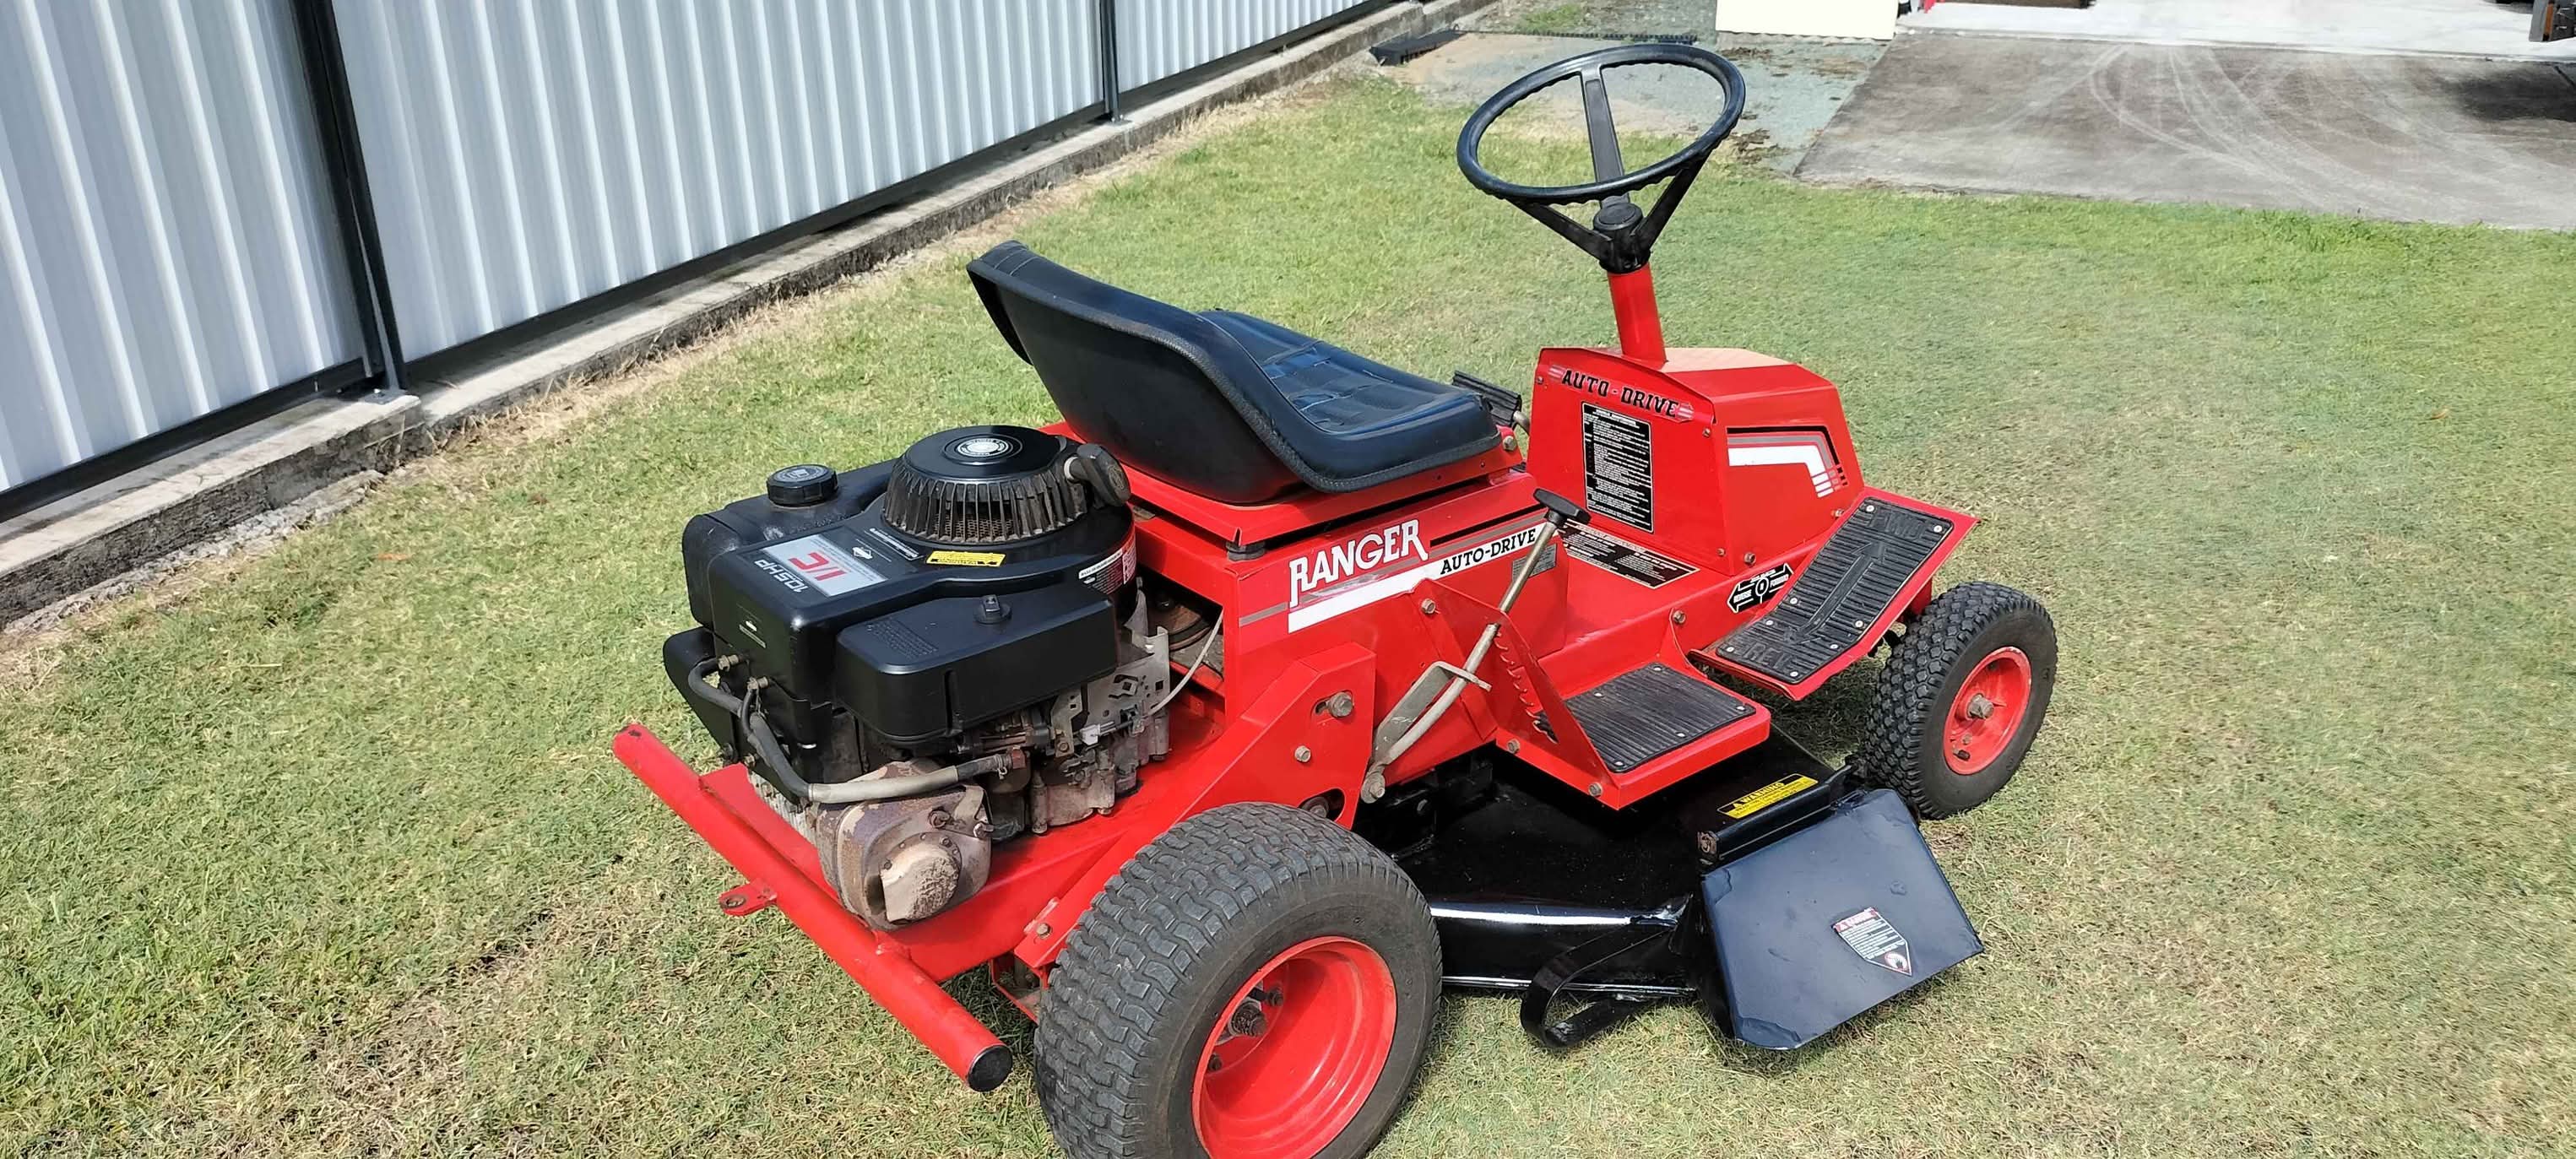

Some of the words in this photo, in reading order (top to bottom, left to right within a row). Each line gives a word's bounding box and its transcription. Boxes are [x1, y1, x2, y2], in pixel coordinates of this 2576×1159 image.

[1562, 370, 1609, 398] AUTO
[1620, 386, 1679, 418] DRIVE
[1289, 519, 1429, 609] RANGER
[1440, 528, 1537, 576] AUTO-DRIVE
[1743, 642, 1792, 669] REV
